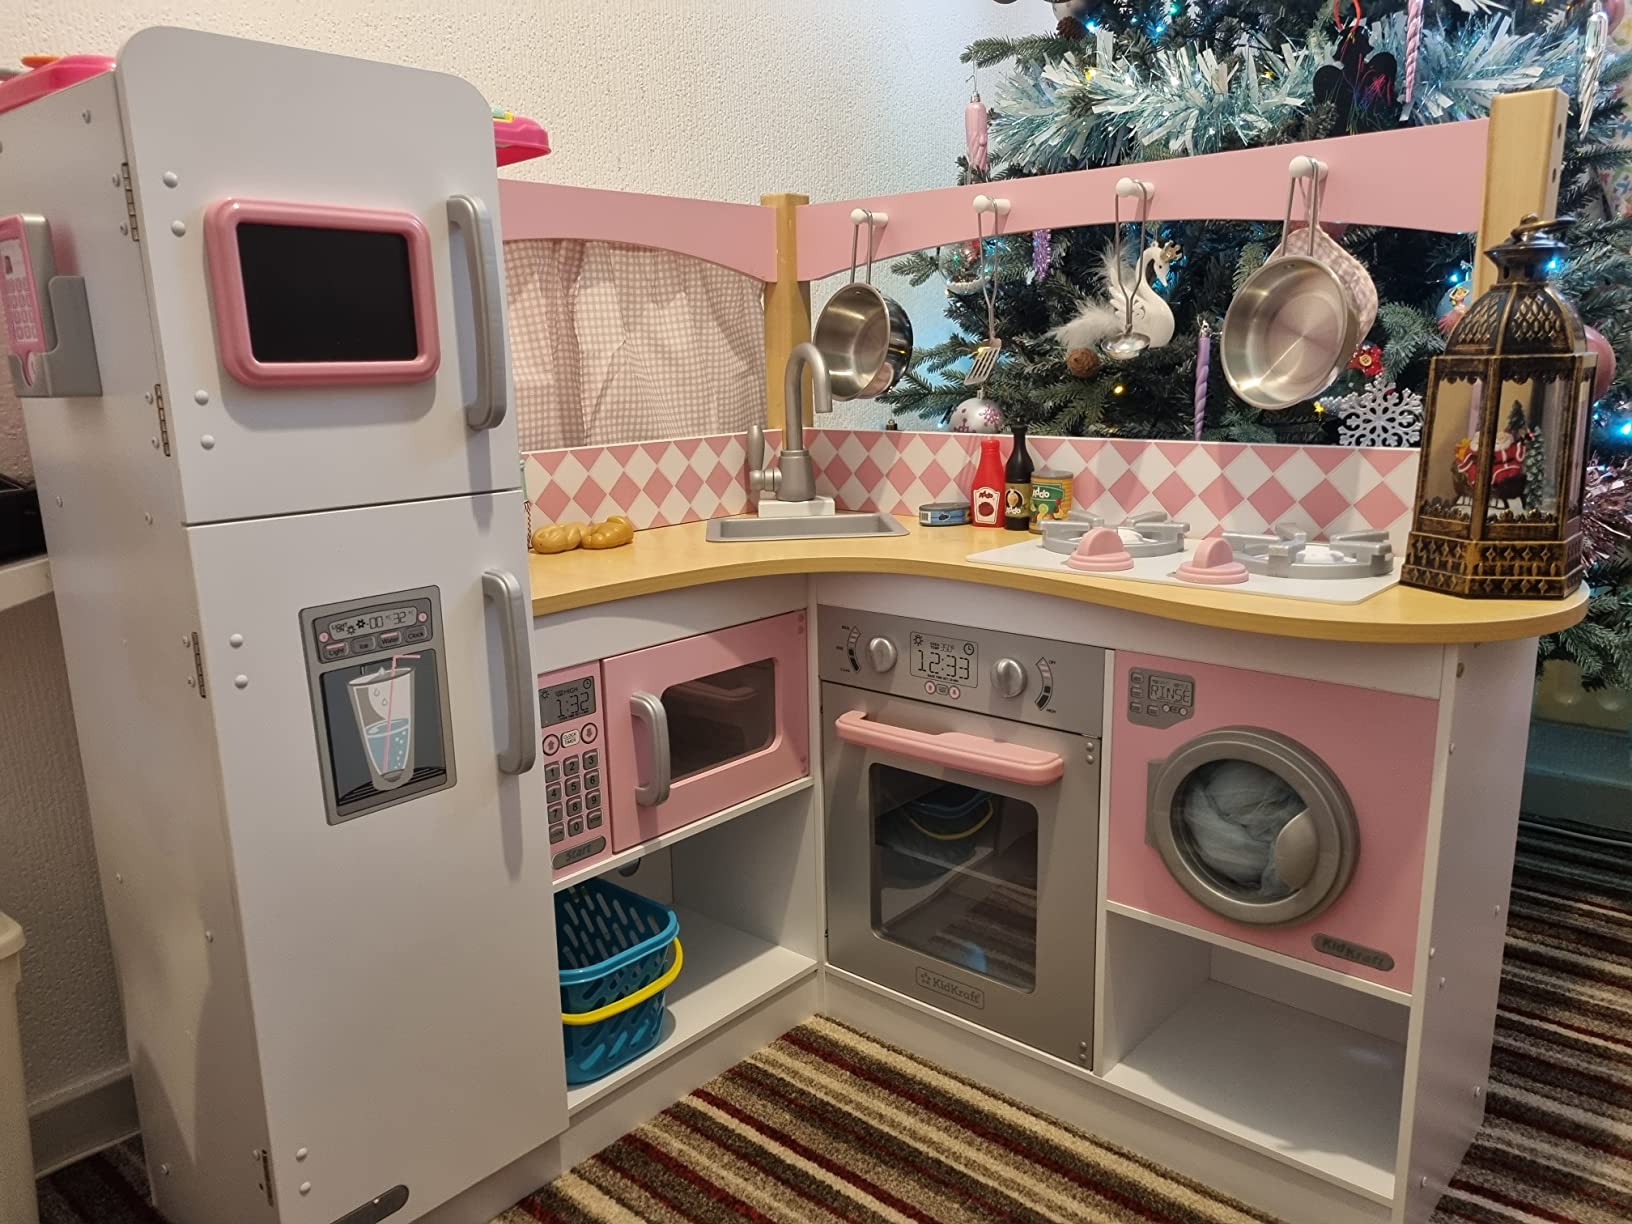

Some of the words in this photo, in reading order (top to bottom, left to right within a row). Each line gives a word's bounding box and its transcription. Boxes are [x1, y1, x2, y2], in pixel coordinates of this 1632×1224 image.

[917, 649, 970, 680] 12:33
[1150, 684, 1191, 704] RINSE
[933, 977, 981, 1004] KidKraft
